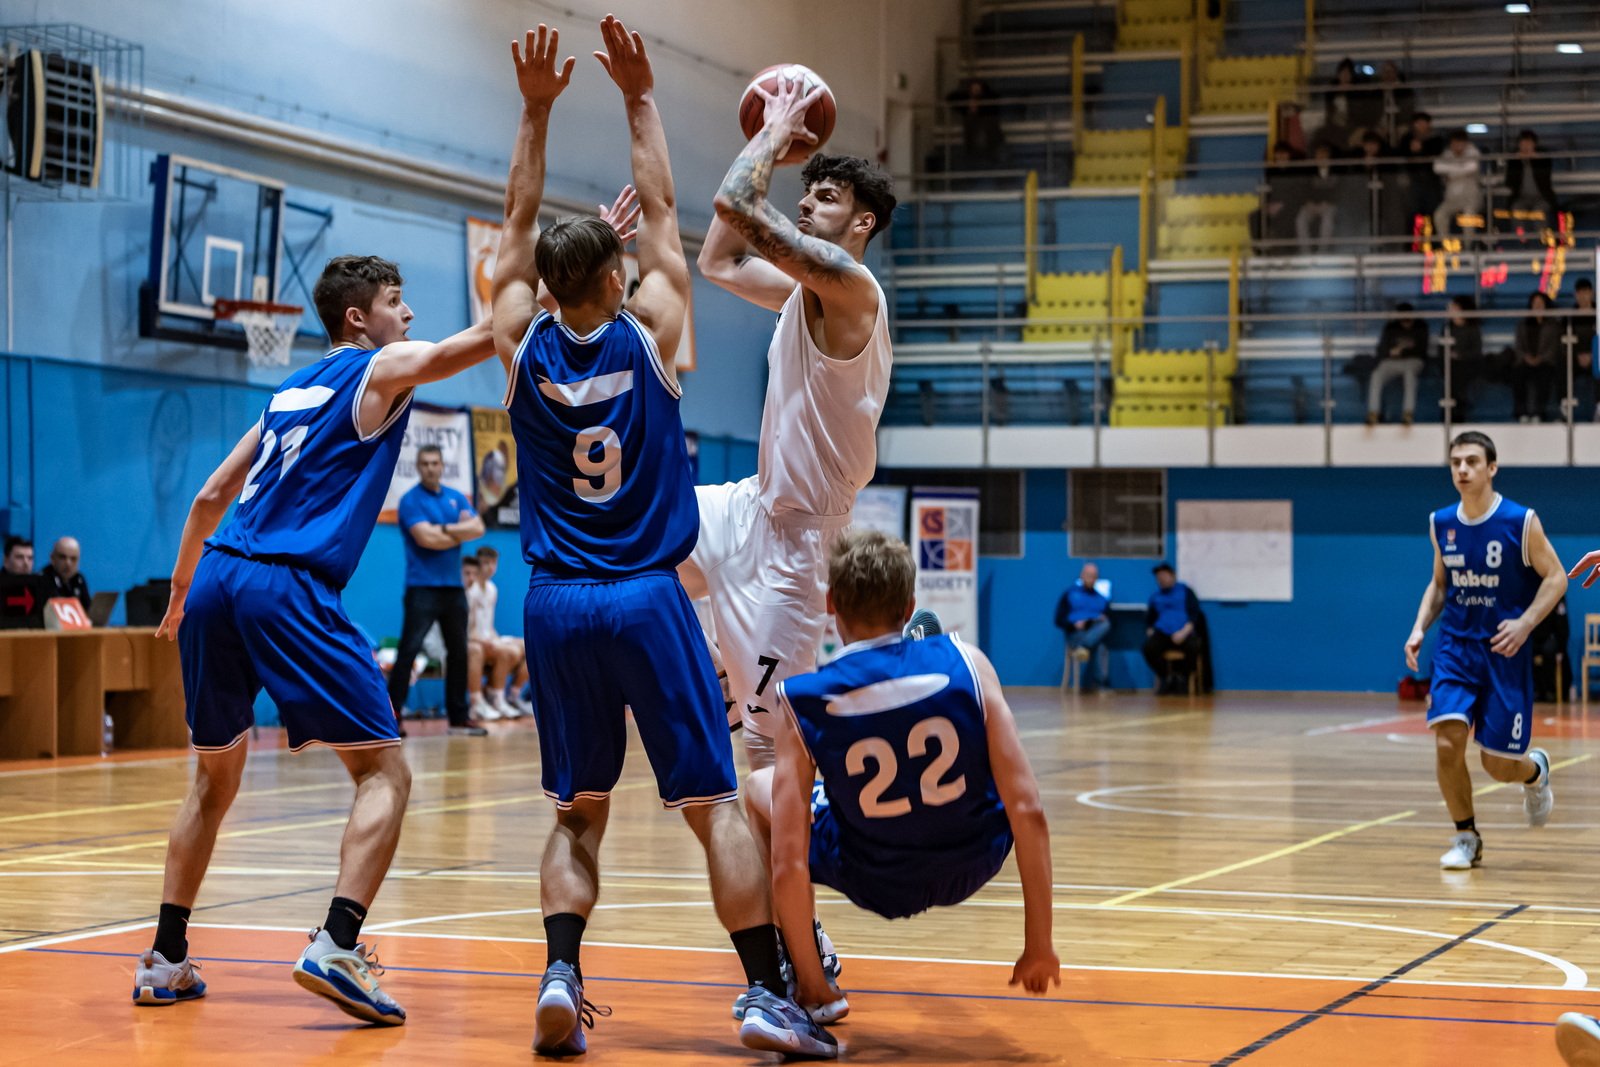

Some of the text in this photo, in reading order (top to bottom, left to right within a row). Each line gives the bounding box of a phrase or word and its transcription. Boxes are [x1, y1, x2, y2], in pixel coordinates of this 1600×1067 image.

[573, 426, 622, 503] 9
[1486, 540, 1503, 569] 8
[757, 655, 780, 697] 7
[1511, 712, 1523, 740] 8
[845, 716, 967, 819] 22
